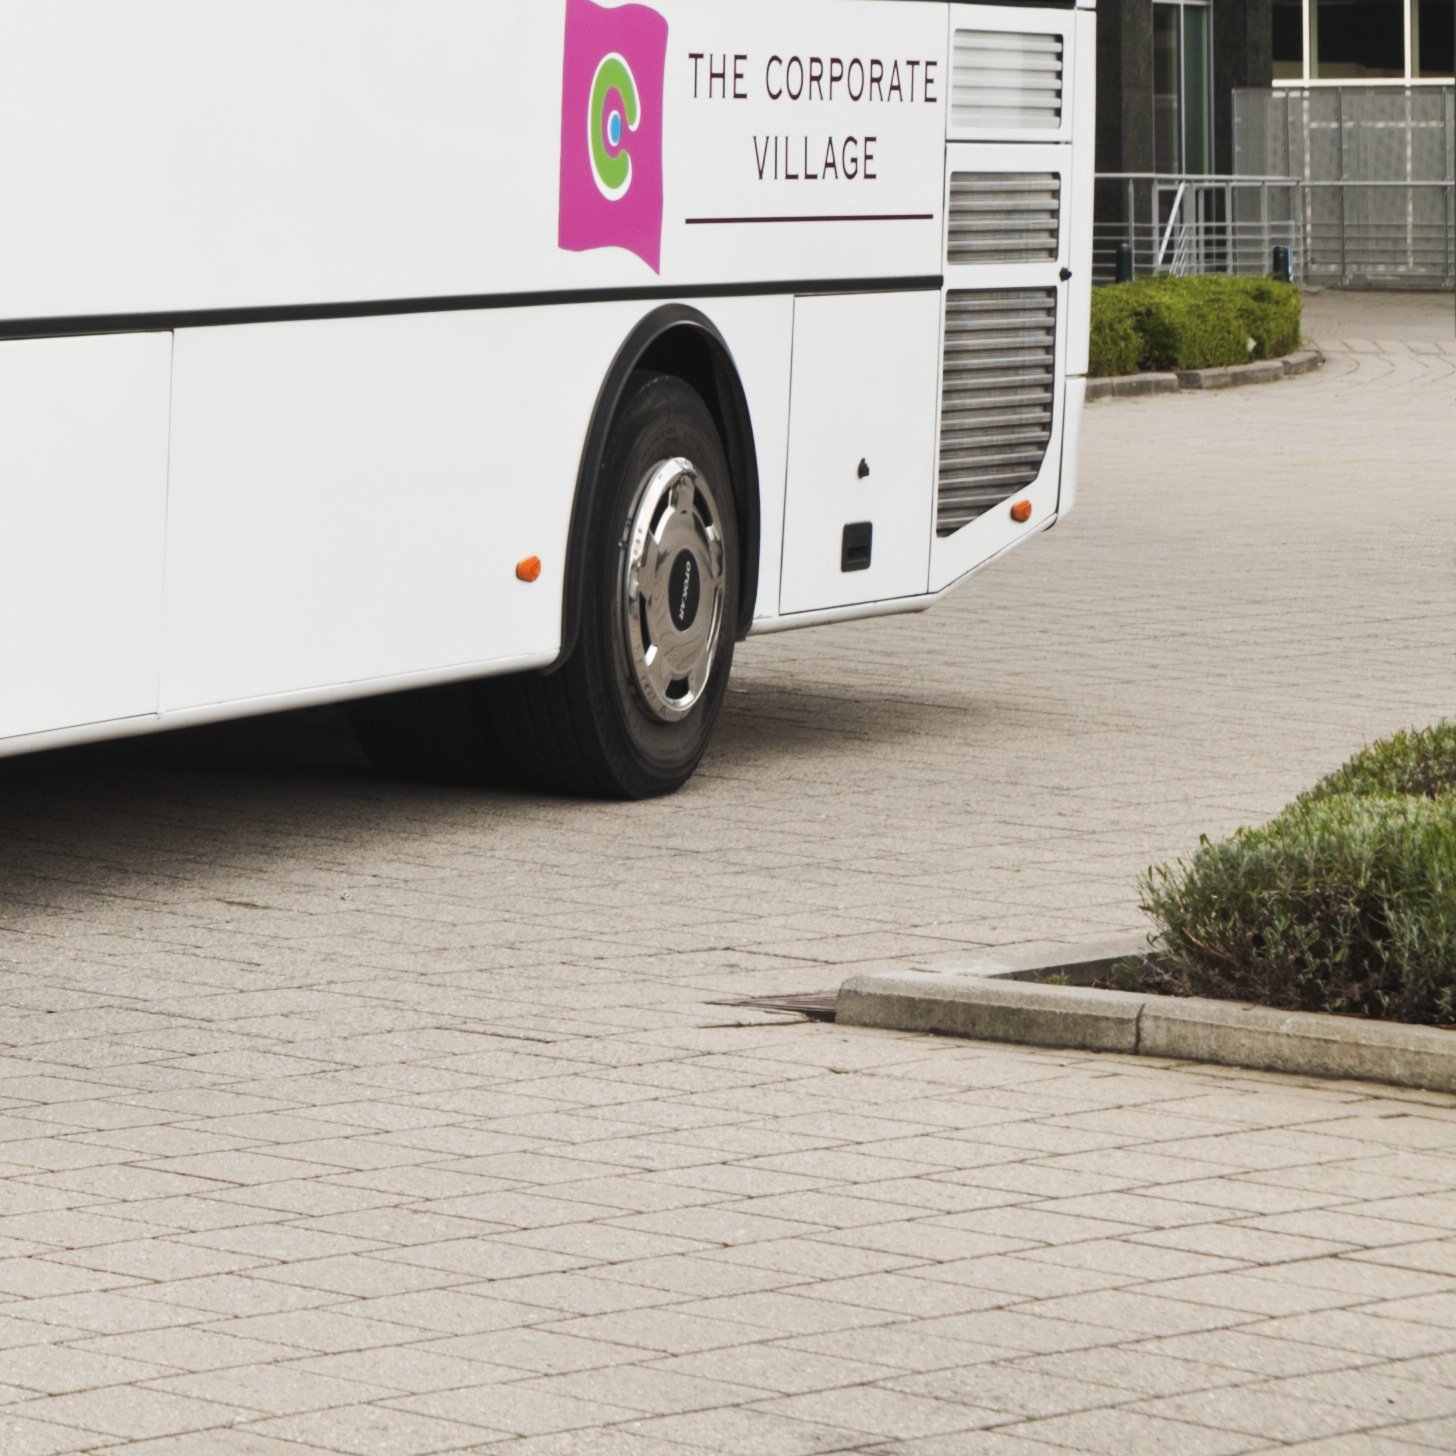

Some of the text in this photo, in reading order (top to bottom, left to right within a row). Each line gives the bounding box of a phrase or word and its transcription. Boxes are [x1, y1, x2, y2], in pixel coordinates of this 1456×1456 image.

[688, 52, 938, 103] THE CORPORATE
[753, 135, 877, 180] VILLAGE
